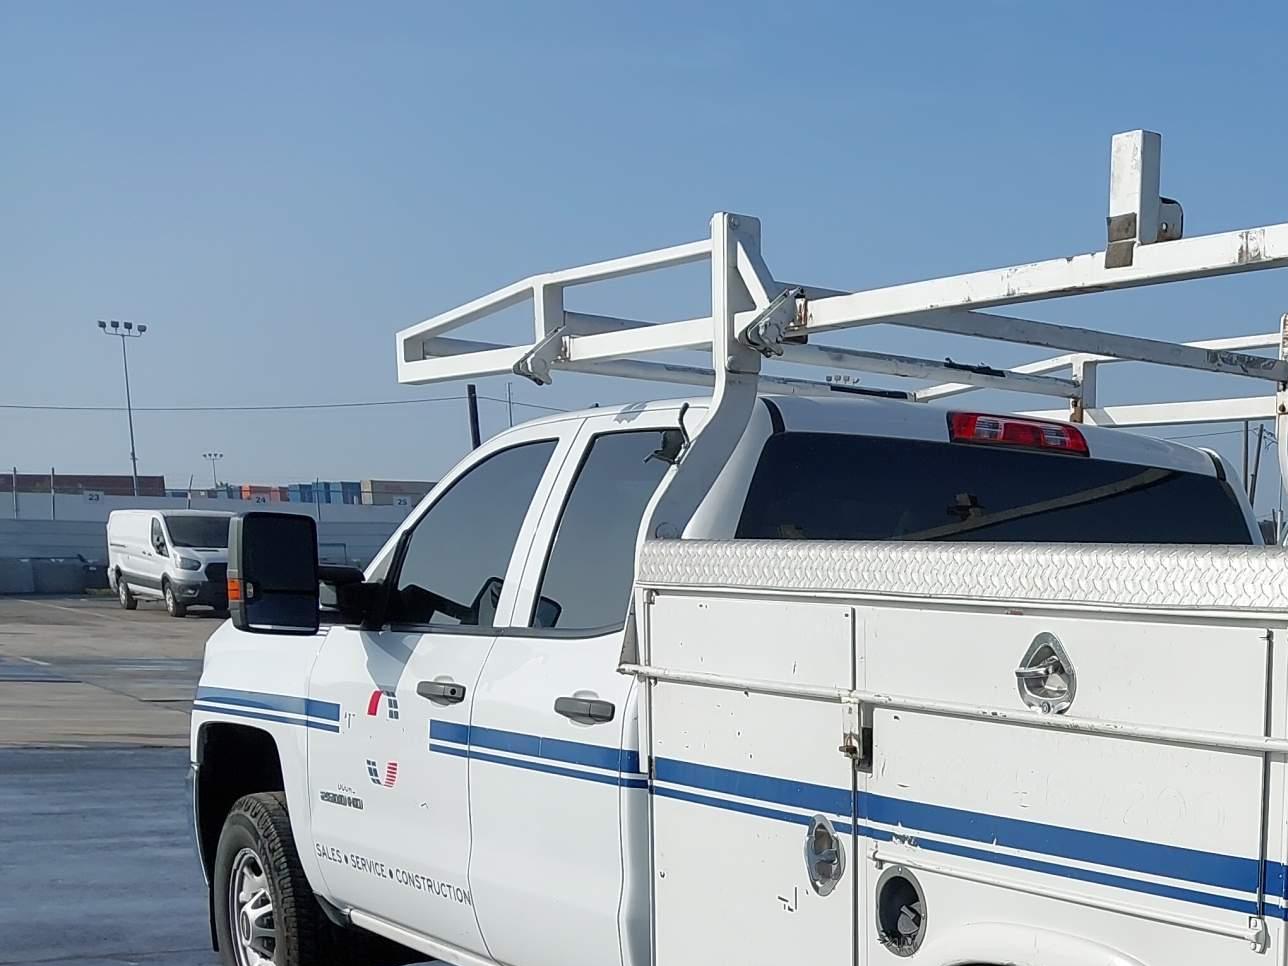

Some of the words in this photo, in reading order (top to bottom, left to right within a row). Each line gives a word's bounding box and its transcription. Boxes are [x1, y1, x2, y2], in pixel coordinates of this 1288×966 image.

[315, 843, 343, 864] SALES
[350, 854, 387, 879] SERVICE
[395, 868, 471, 907] CONSTRUCTION
